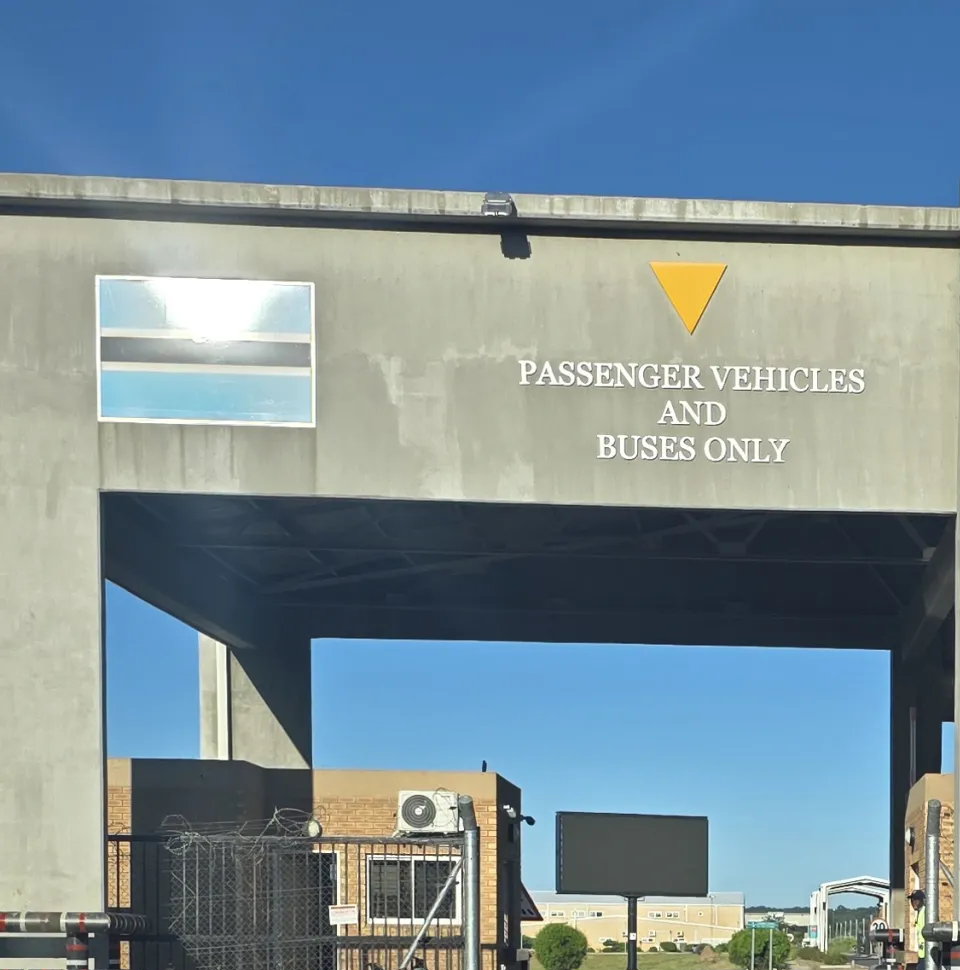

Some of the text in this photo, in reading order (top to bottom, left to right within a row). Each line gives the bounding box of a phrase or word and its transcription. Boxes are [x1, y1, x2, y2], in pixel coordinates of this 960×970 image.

[517, 360, 866, 393] PASSENGER VEHICLES
[657, 400, 727, 426] AND
[596, 434, 791, 463] BUSES ONLY
